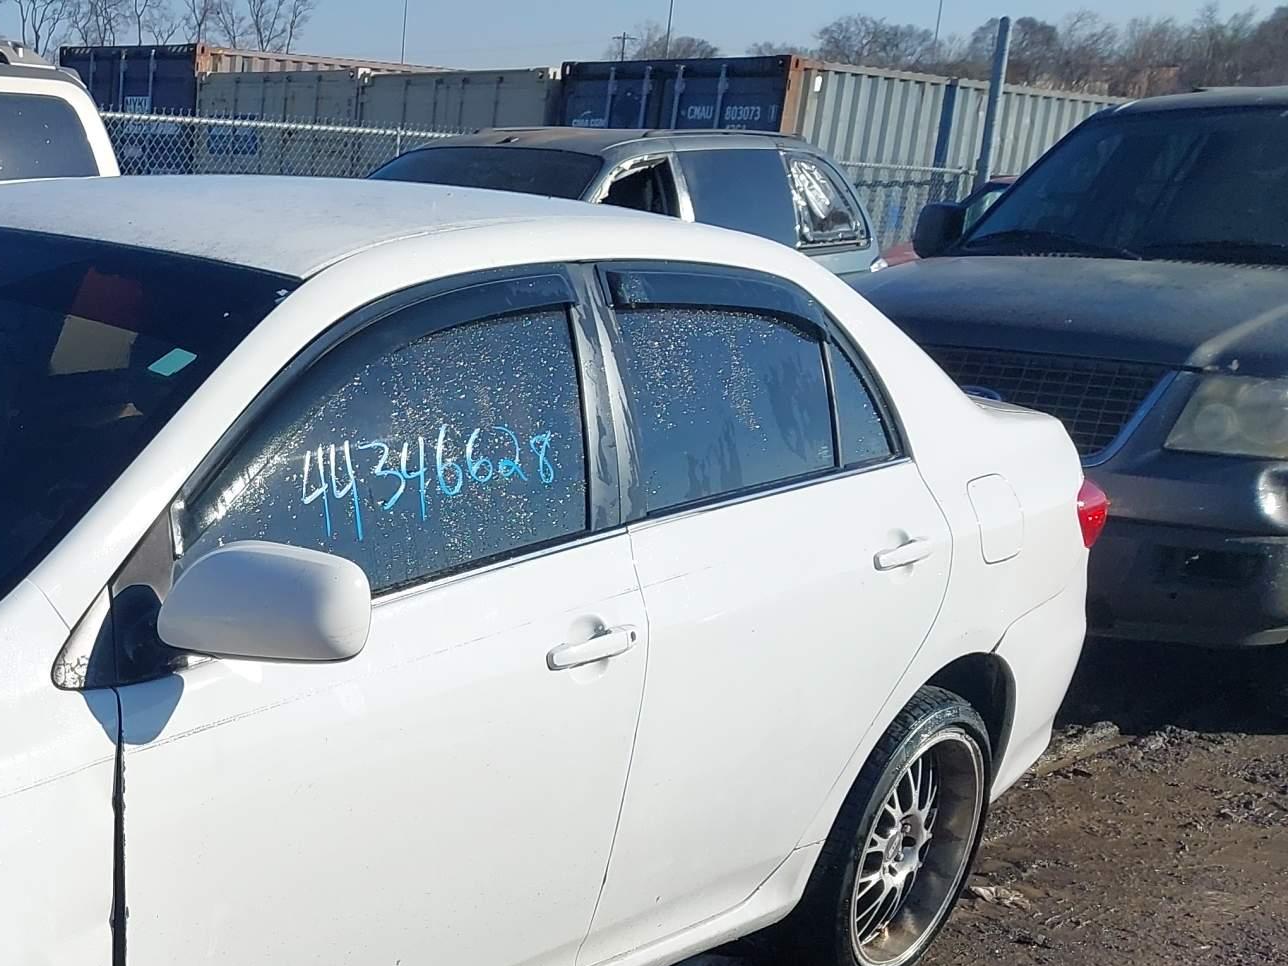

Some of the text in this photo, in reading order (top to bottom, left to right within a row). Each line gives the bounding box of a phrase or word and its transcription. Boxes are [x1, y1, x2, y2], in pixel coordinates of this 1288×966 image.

[687, 106, 713, 119] CMAU
[724, 106, 761, 120] 803073
[301, 424, 555, 541] 44346628
